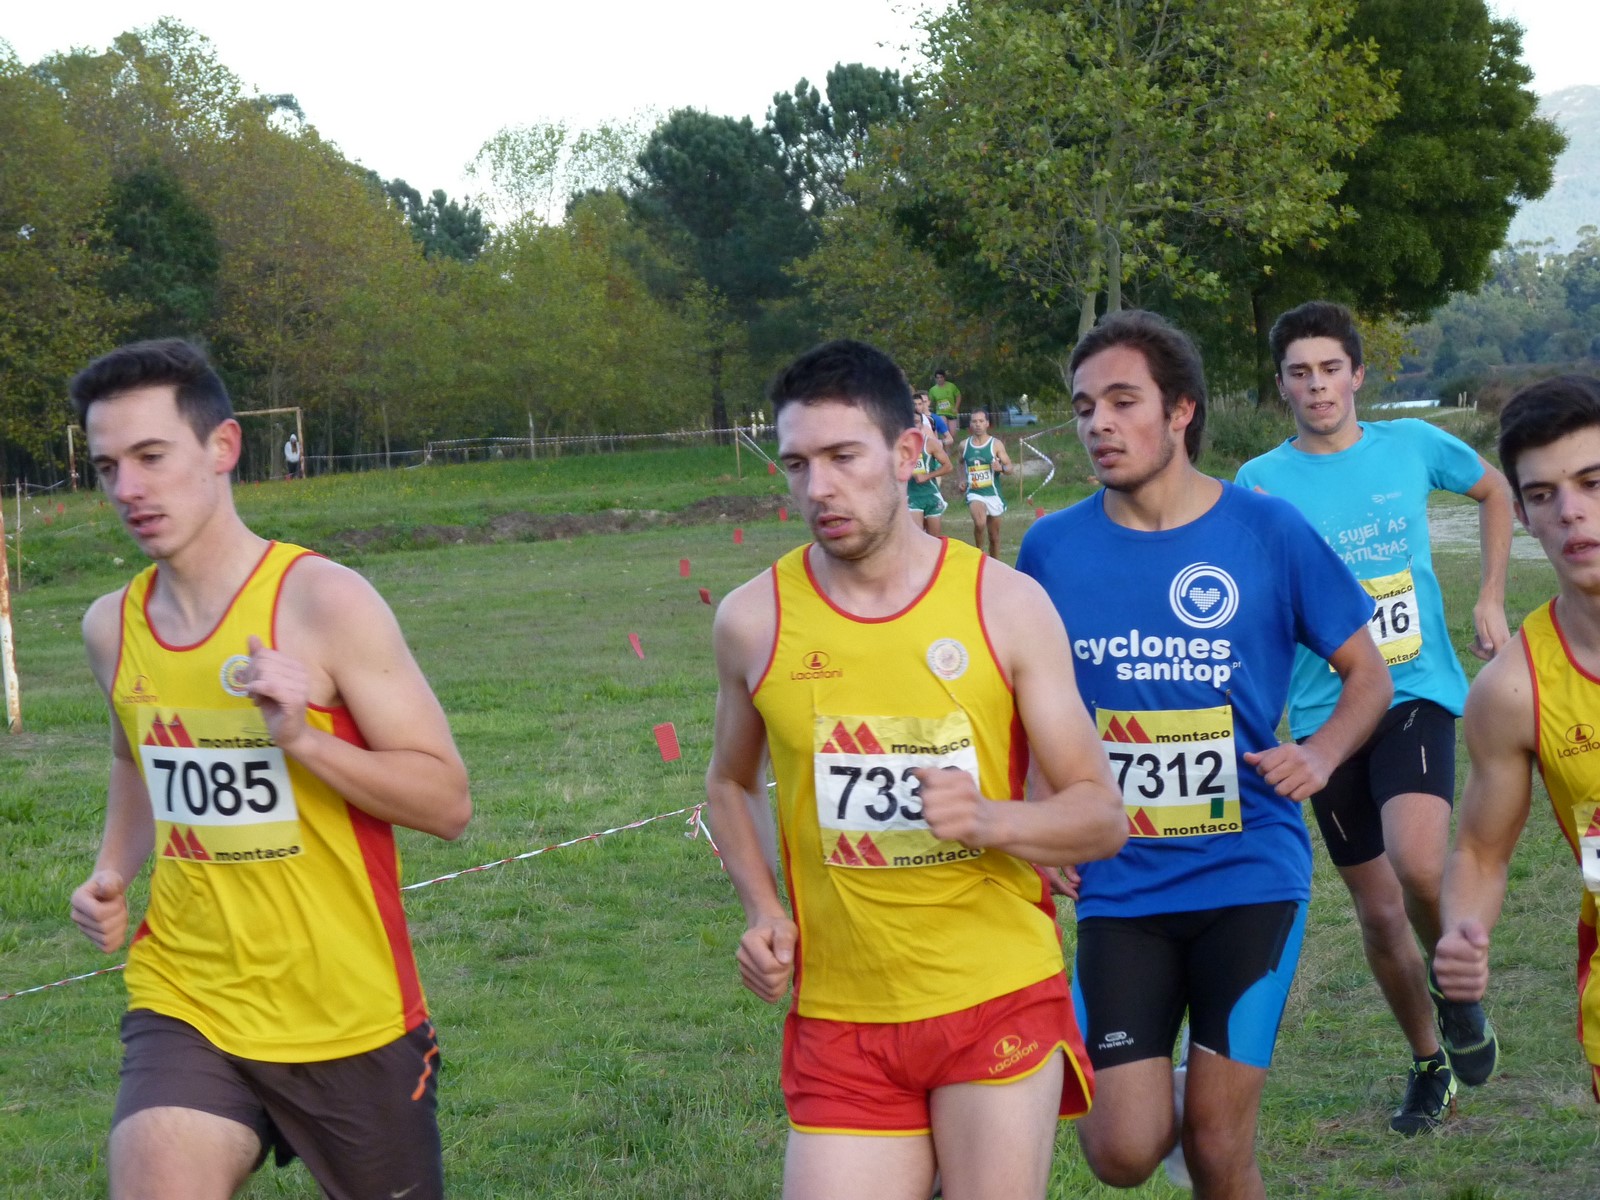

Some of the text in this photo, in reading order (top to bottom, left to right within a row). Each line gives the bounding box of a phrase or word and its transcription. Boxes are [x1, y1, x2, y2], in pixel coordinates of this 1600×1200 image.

[1387, 516, 1407, 533] AS
[1340, 538, 1408, 564] ATILHAS
[1074, 629, 1231, 665] cyclones
[790, 668, 843, 680] Lacatoni
[1116, 657, 1231, 688] sanitop
[891, 738, 970, 755] montaco
[1156, 729, 1231, 743] montaco
[1109, 750, 1225, 799] 7312
[153, 758, 278, 816] 7085
[830, 765, 963, 822] 733
[1163, 821, 1239, 836] montaco
[215, 846, 301, 861] montaco
[893, 848, 980, 866] montaco
[989, 1040, 1038, 1075] Lacatoni
